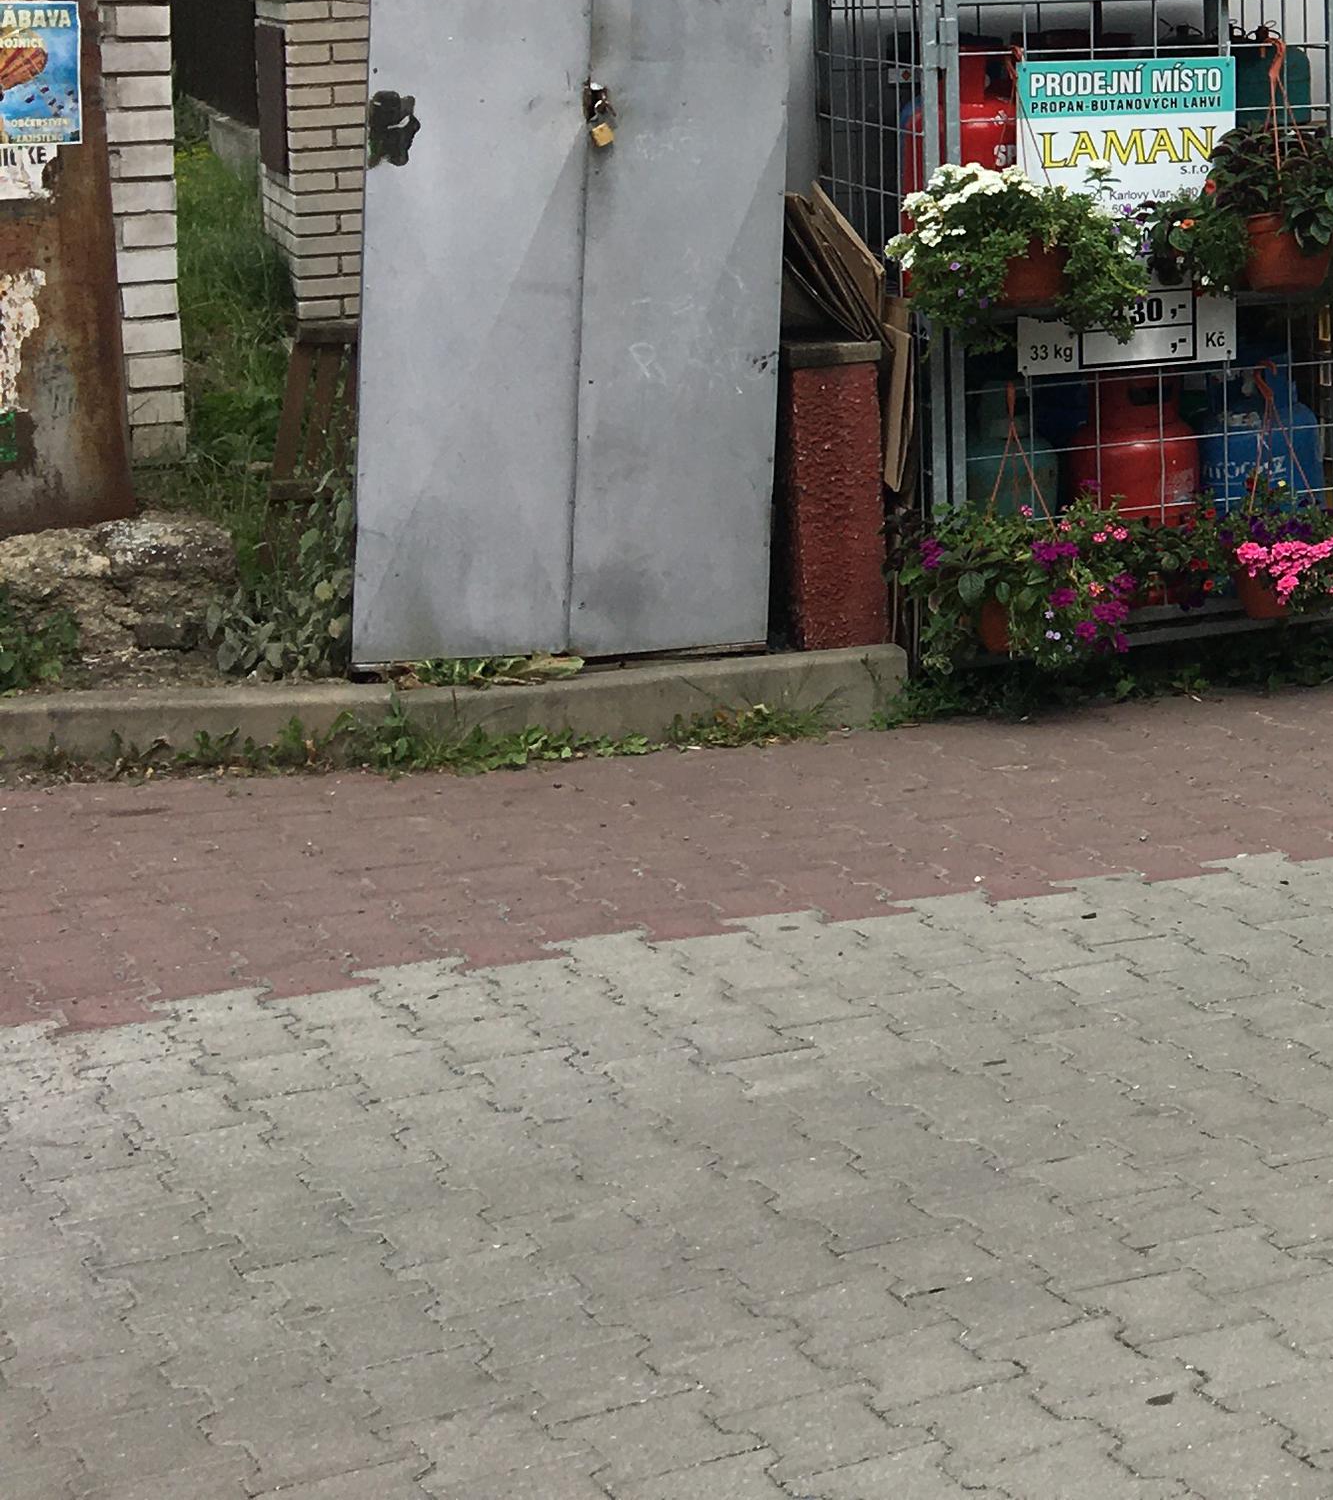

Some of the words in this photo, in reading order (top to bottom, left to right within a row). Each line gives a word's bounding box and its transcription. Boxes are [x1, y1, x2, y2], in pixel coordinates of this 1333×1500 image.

[1029, 62, 1147, 98] PRODEJNÍ
[1152, 61, 1223, 95] MÍSTO
[1031, 94, 1178, 114] PROPAN-BUTANOVÝCH
[1037, 125, 1217, 169] LAMAN
[1109, 189, 1150, 202] Karlovy
[1205, 331, 1226, 348] Kč
[1030, 344, 1048, 361] 33
[1054, 344, 1073, 363] kg
